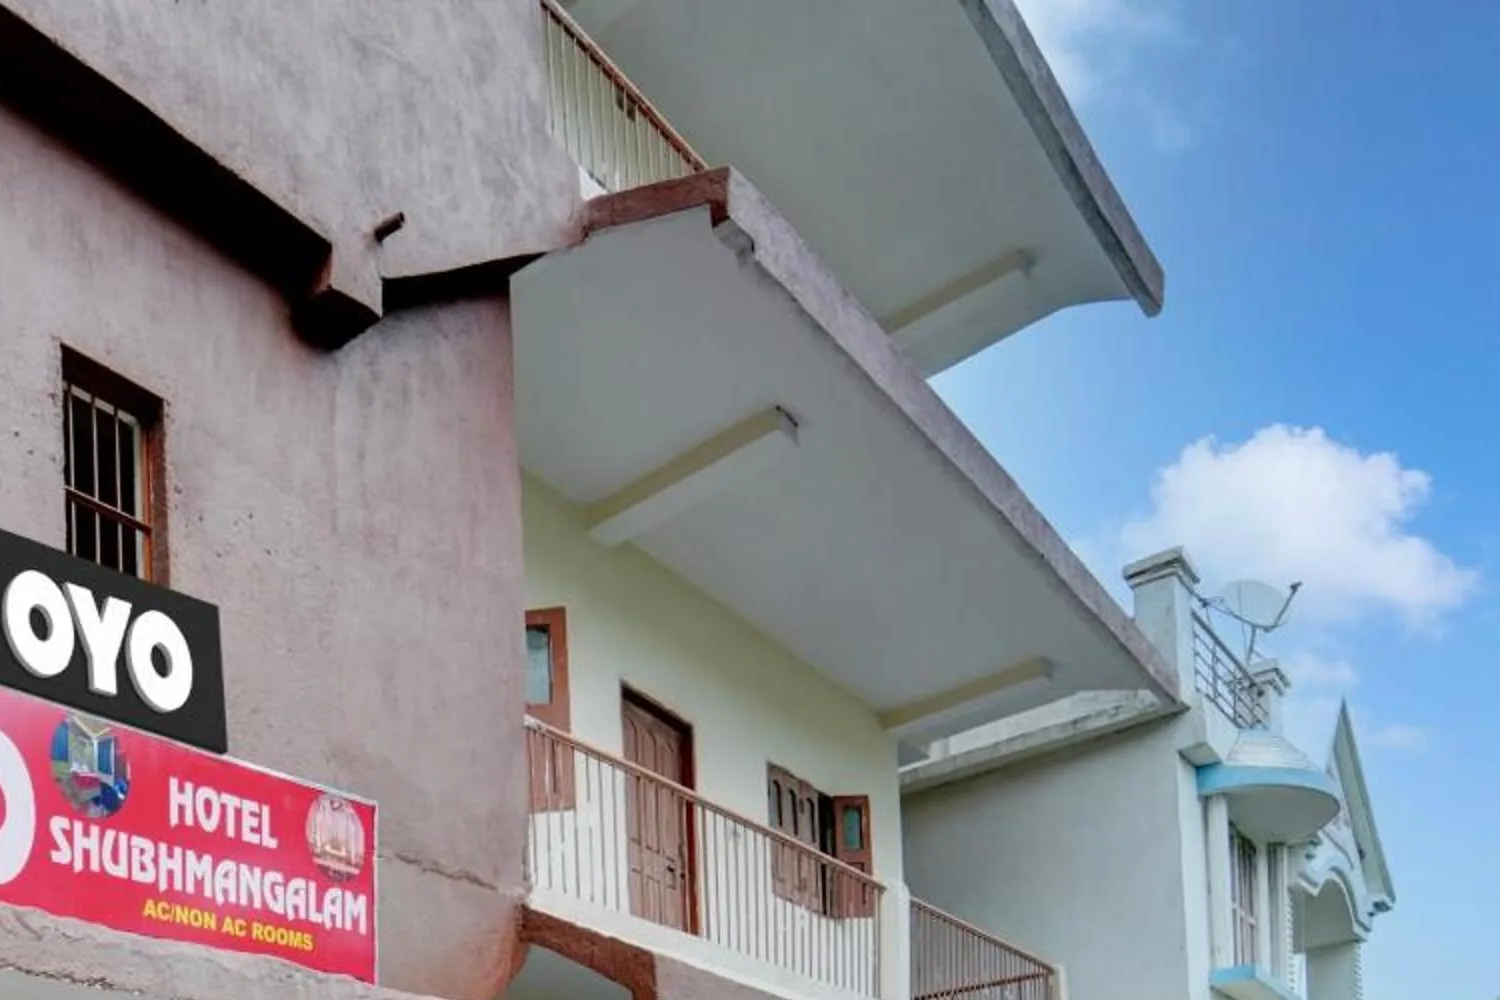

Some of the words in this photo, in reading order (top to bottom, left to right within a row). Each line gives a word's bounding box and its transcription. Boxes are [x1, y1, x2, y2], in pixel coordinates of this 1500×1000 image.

[3, 569, 193, 713] OYO
[169, 776, 279, 849] HOTEL
[49, 815, 368, 935] SHUBHMANGALAM
[142, 898, 217, 931] AC/NON
[221, 917, 247, 938] AC
[252, 922, 315, 952] ROOMS
